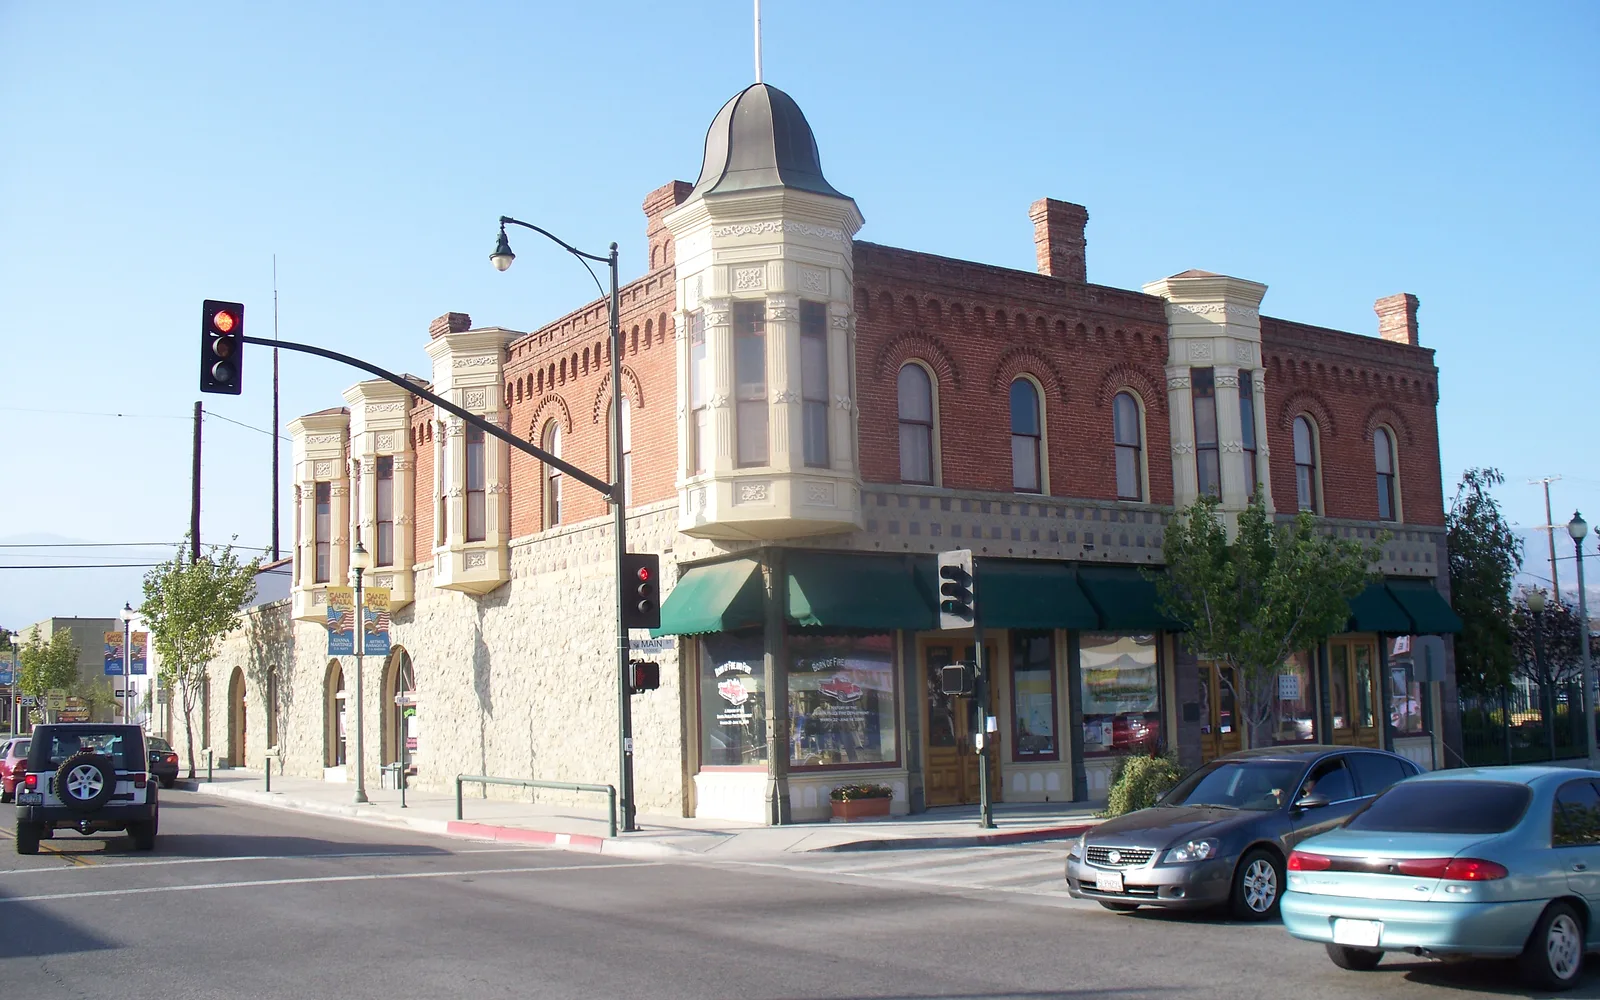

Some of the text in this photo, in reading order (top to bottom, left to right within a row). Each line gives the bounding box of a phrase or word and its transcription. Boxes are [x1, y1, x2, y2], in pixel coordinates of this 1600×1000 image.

[641, 640, 662, 648] MAIN
[811, 659, 826, 672] BORN
[826, 658, 833, 667] OF
[833, 657, 844, 666] FIRE
